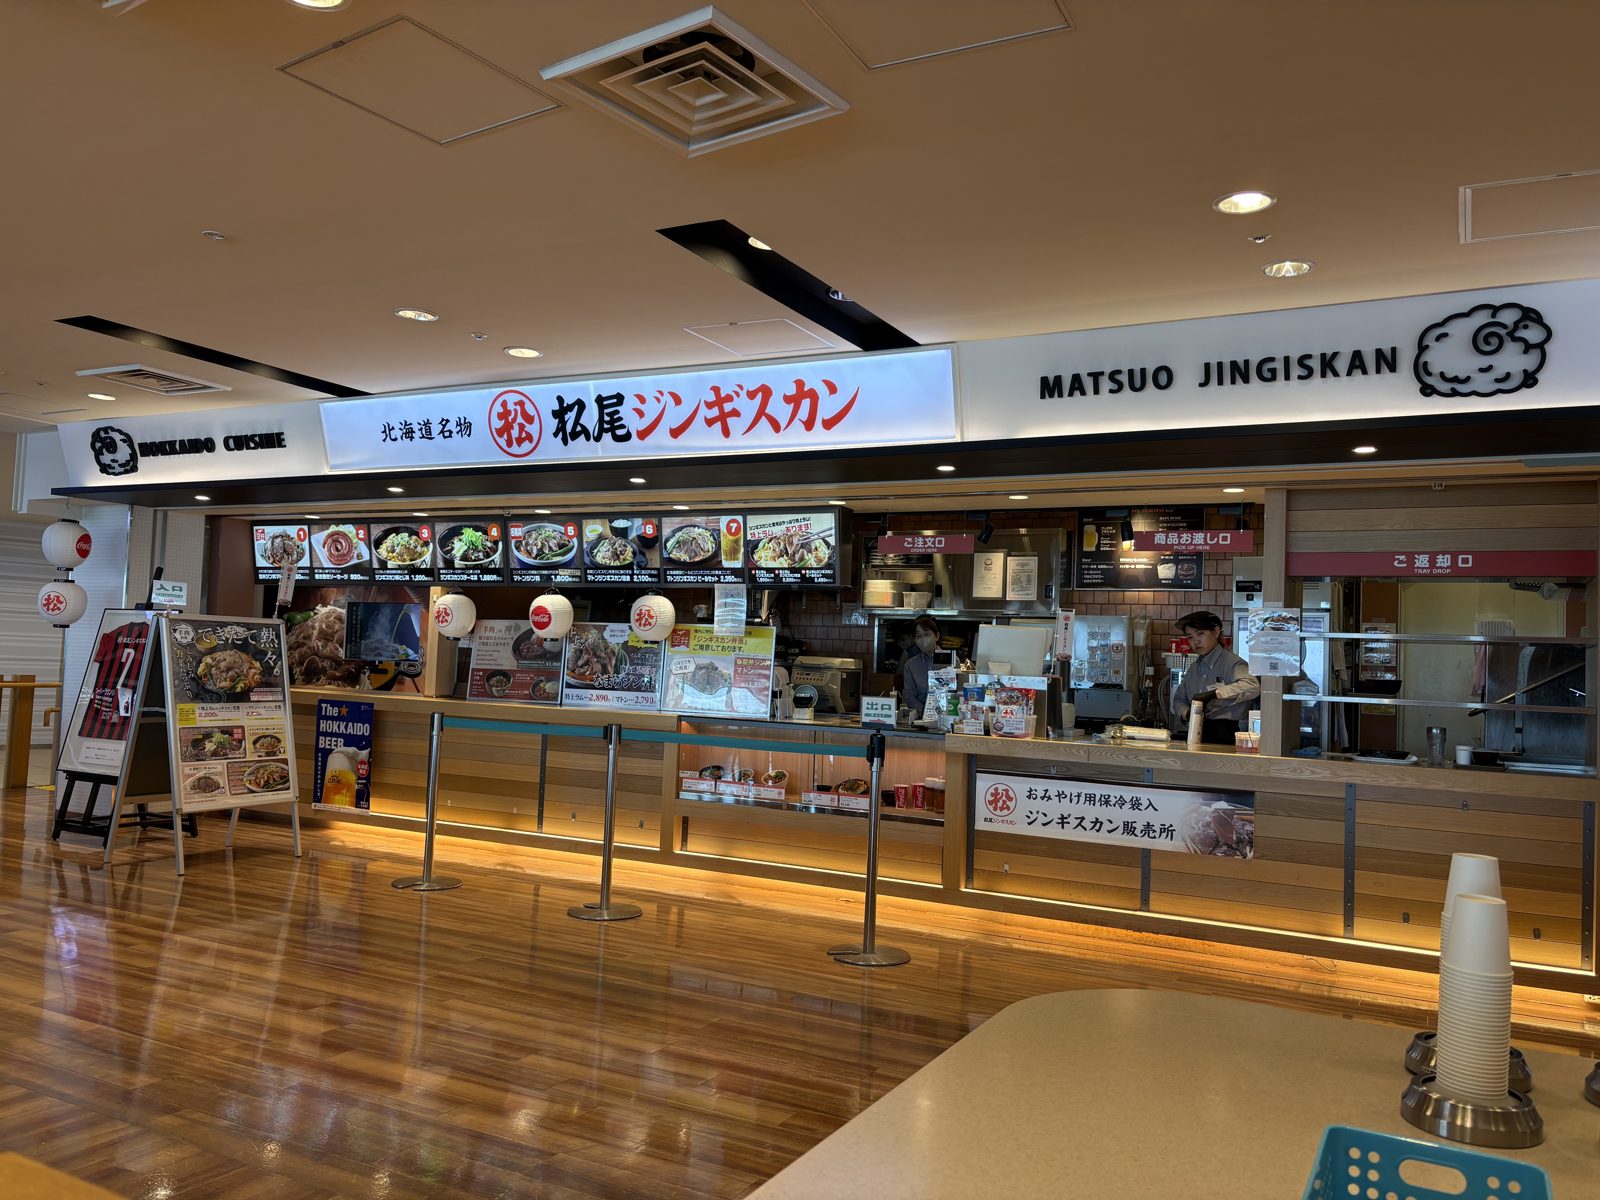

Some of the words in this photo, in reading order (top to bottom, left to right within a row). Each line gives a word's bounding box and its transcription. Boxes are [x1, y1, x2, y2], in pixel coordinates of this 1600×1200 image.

[1039, 365, 1174, 400] MATSUO
[1198, 346, 1398, 388] JINGISKAN
[552, 379, 861, 447] 松尾ジンギスカン
[380, 416, 474, 443] 北海道名物
[494, 401, 537, 447] 松
[138, 437, 216, 457] HOKKAIDO
[223, 432, 287, 451] CUISINE
[904, 537, 945, 548] ご注文口
[1154, 533, 1231, 545] 商品お渡し口
[1393, 554, 1474, 568] ご返却口
[155, 583, 183, 593] 入口
[42, 593, 65, 613] 松
[434, 606, 451, 624] 松
[634, 608, 655, 628] 松
[692, 645, 745, 653] ご用意しております。
[693, 636, 748, 646] 「ジンギスカン弁当」
[321, 703, 339, 717] The
[866, 702, 892, 712] 出口
[319, 719, 370, 736] HOKKAIDO
[318, 736, 345, 750] BEER
[987, 786, 1014, 812] 松
[1026, 786, 1159, 812] おみやげ用保冷袋入
[983, 816, 1017, 826] 松尾ジンギスカン
[1025, 809, 1176, 841] ジンギスカン販売所
